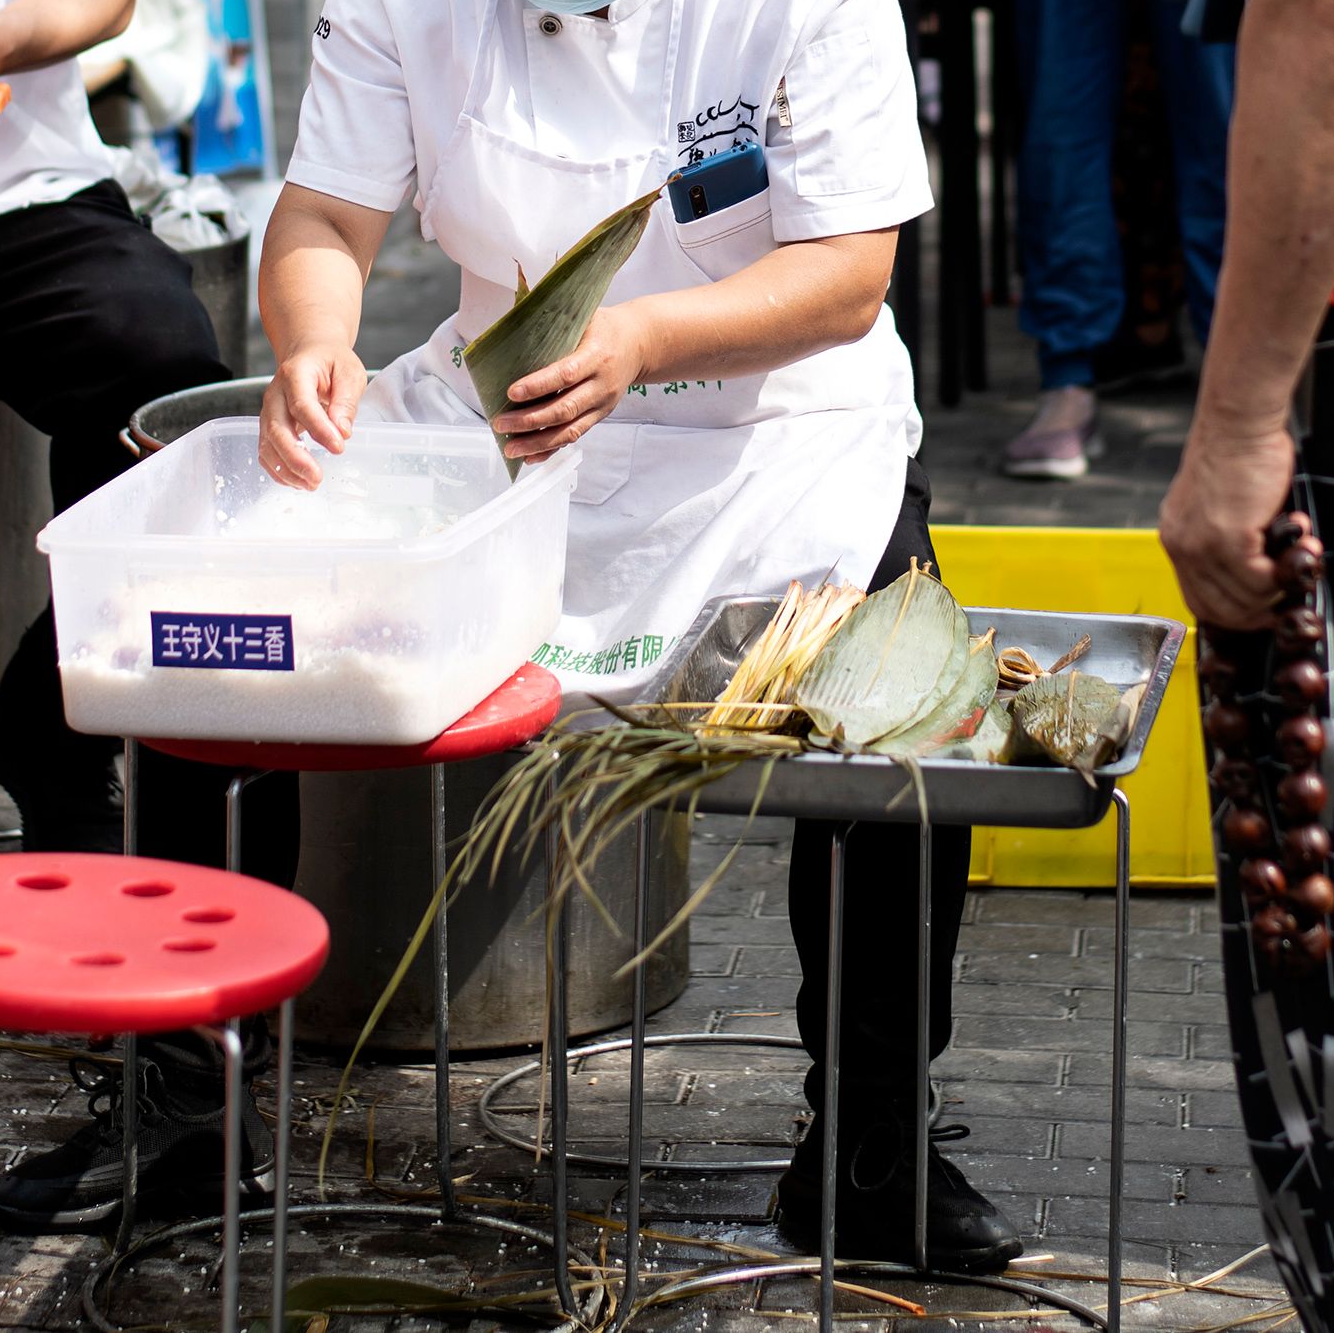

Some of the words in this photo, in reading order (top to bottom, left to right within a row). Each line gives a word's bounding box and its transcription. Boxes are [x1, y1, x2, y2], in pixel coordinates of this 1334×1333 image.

[161, 622, 286, 664] 王守义十三香
[531, 634, 681, 675] 科技股份有限
